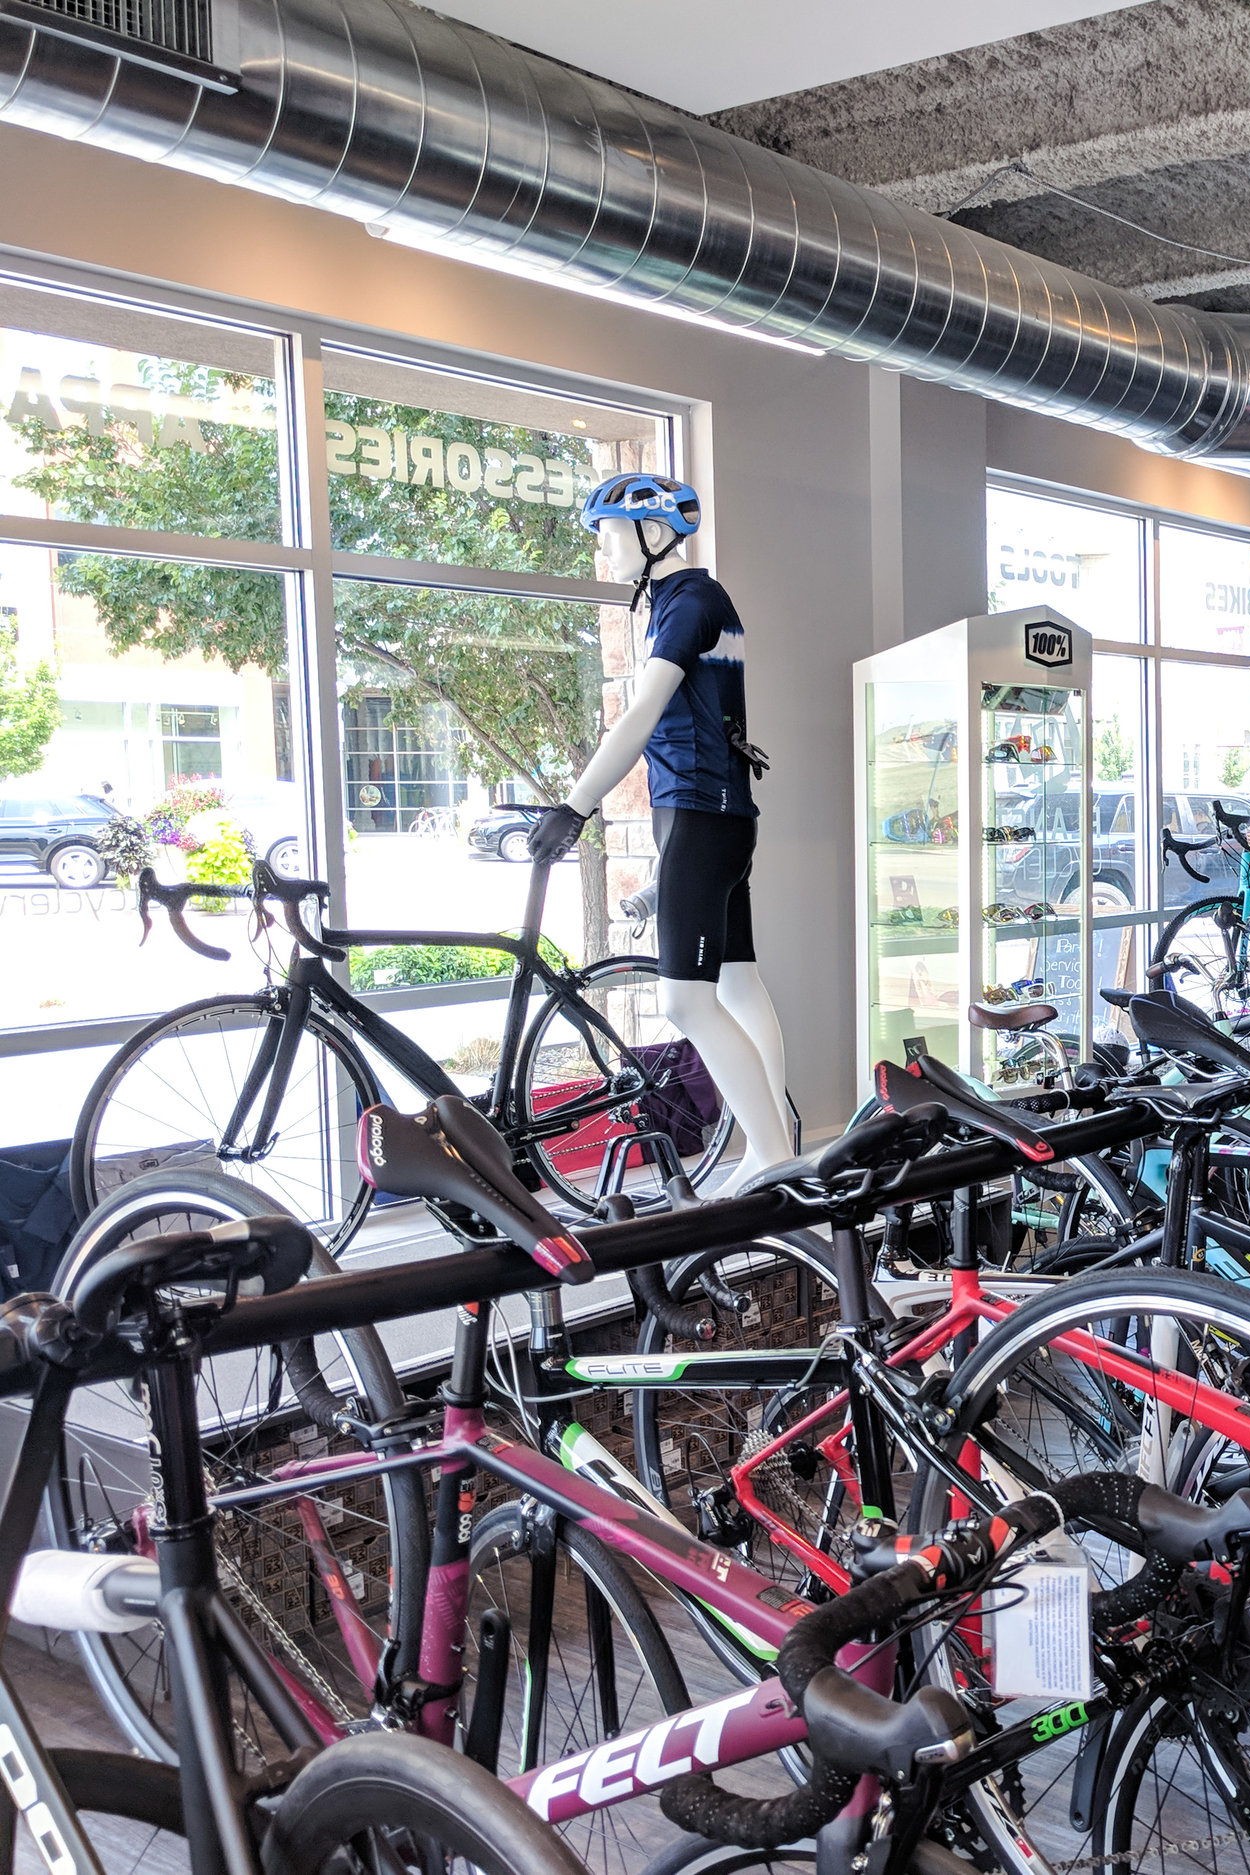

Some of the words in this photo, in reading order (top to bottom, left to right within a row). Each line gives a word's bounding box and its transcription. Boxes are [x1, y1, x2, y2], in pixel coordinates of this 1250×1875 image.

[1031, 631, 1067, 658] 100%
[1030, 1701, 1090, 1743] 300
[526, 1687, 760, 1823] FELT
